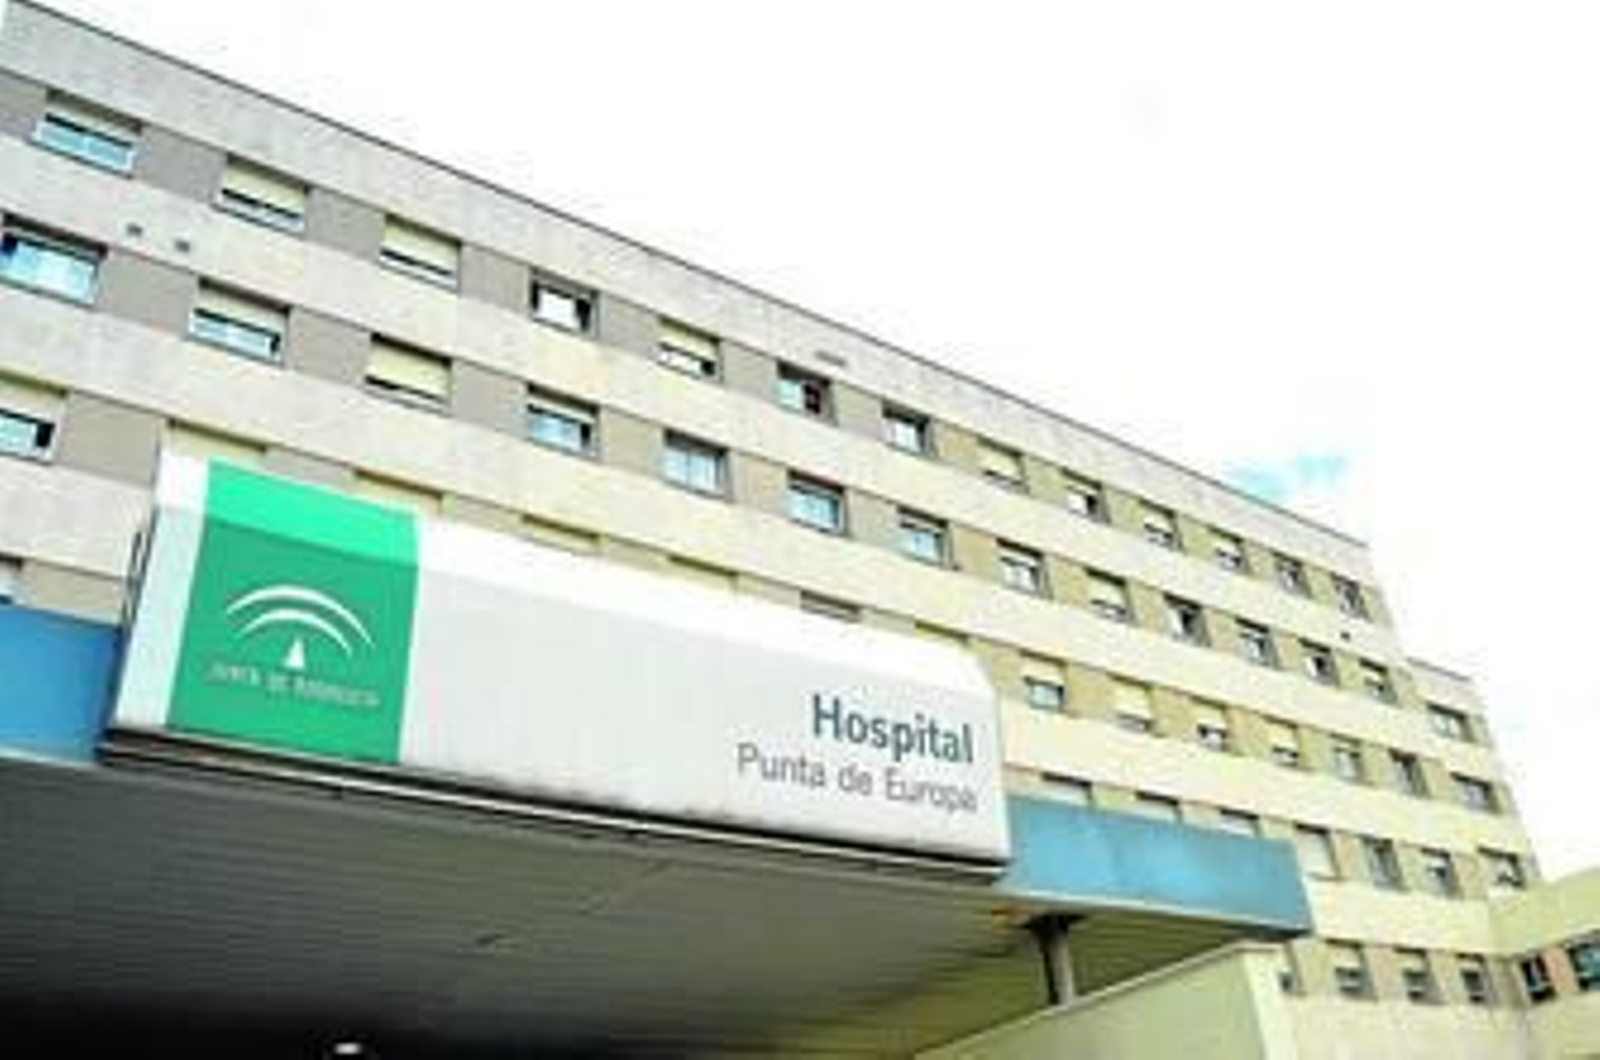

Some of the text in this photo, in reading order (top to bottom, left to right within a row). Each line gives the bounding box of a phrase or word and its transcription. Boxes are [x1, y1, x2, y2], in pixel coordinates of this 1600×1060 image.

[812, 693, 973, 763] Hospital
[737, 742, 977, 814] Punta de Europa
